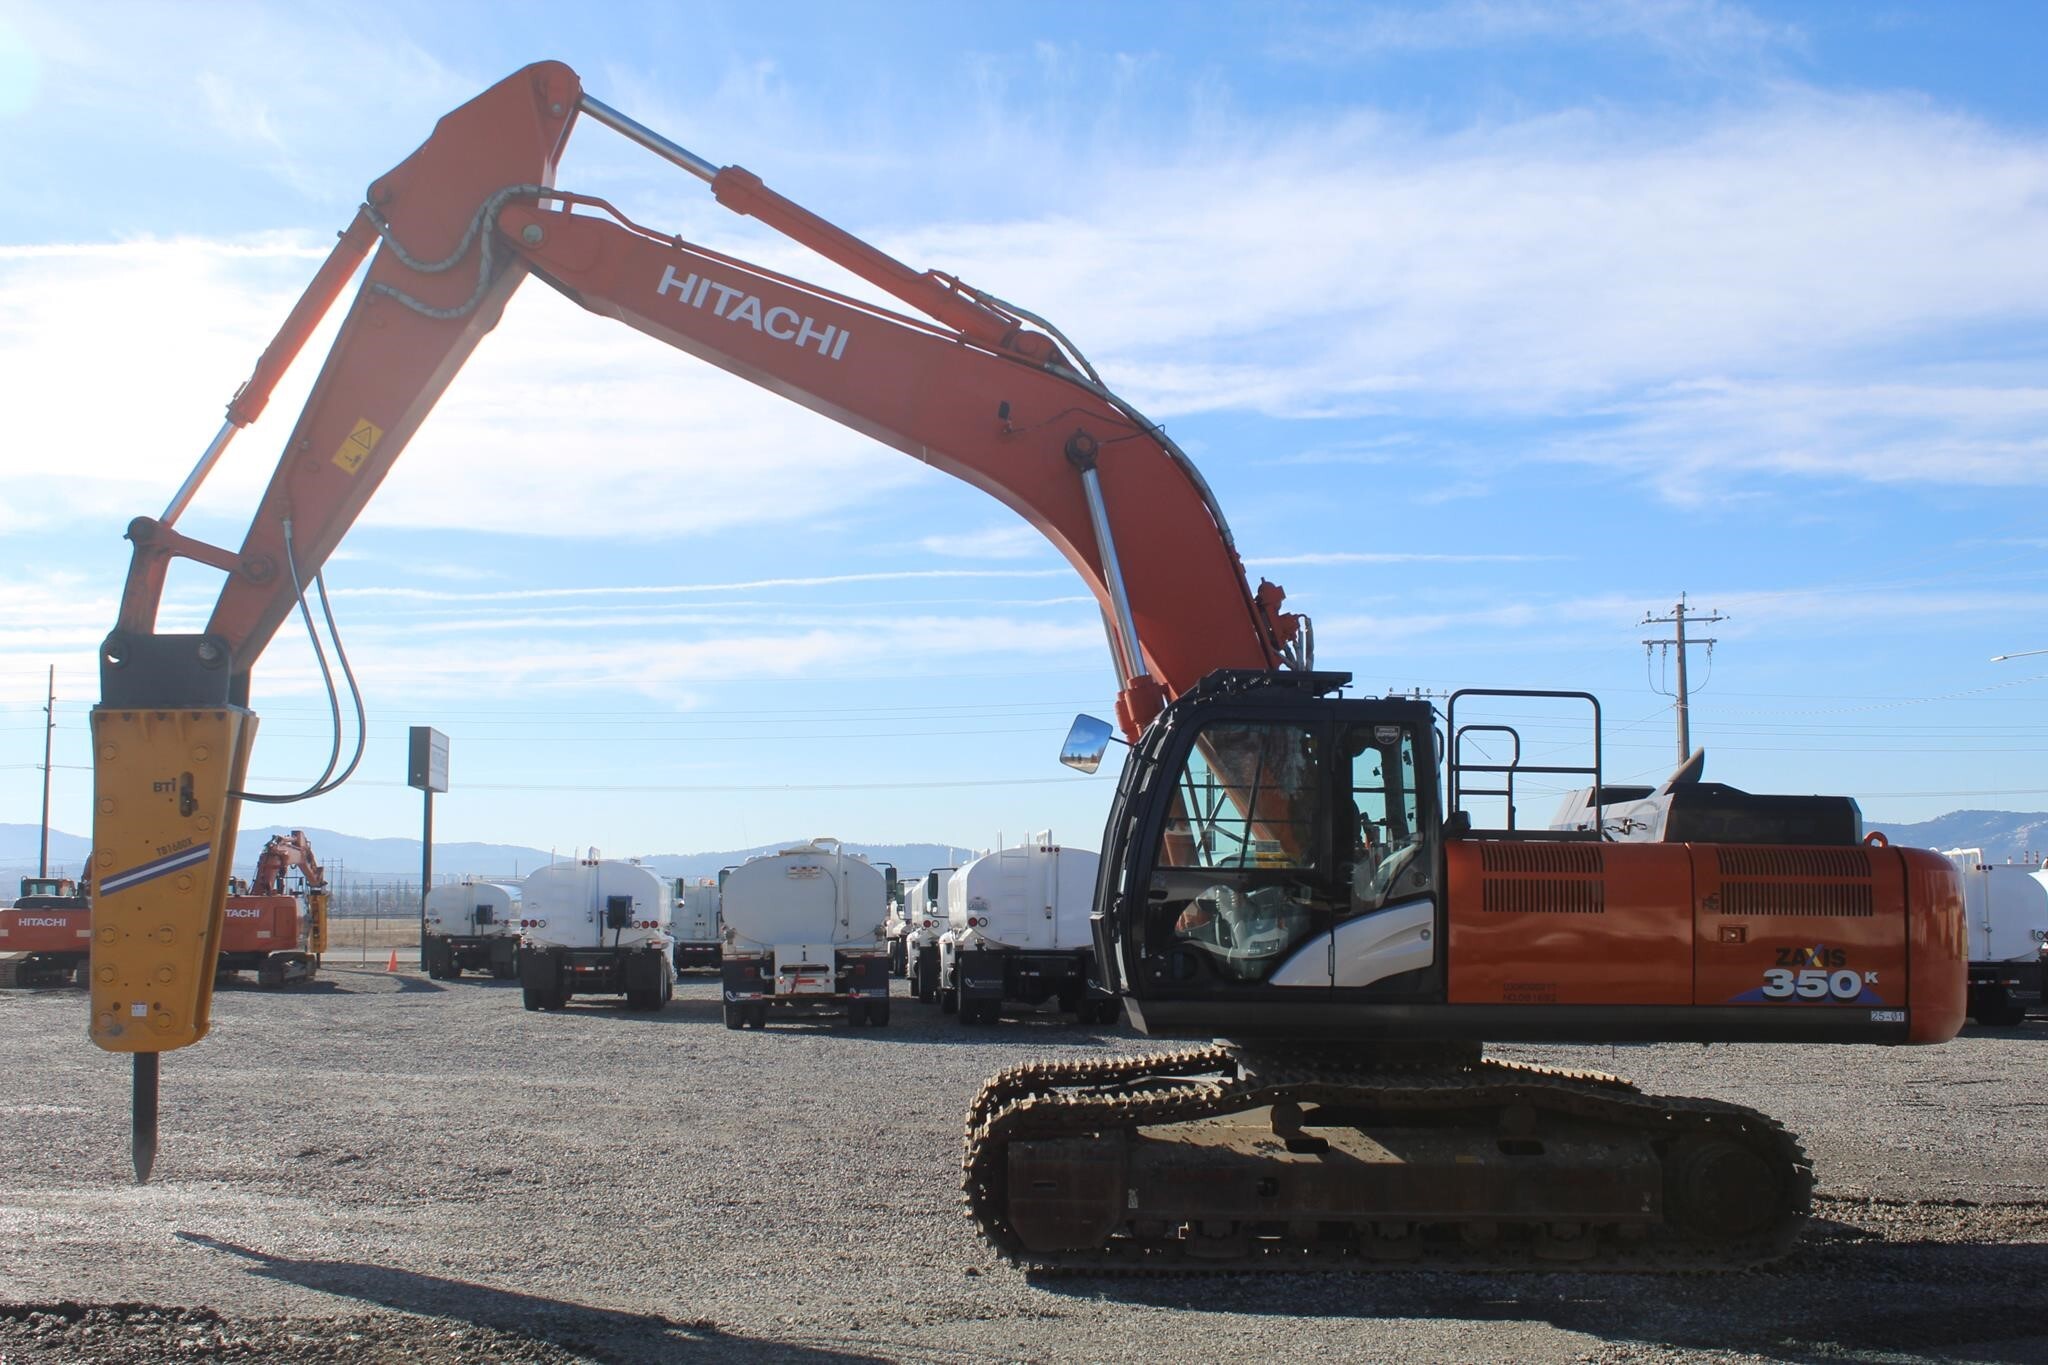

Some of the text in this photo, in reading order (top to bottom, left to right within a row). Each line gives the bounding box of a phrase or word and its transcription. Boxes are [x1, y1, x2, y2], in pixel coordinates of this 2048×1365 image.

[656, 265, 850, 361] HITACHI
[224, 909, 260, 918] TACHI
[18, 918, 66, 927] HITACHI
[1776, 944, 1846, 967] ZAXIS
